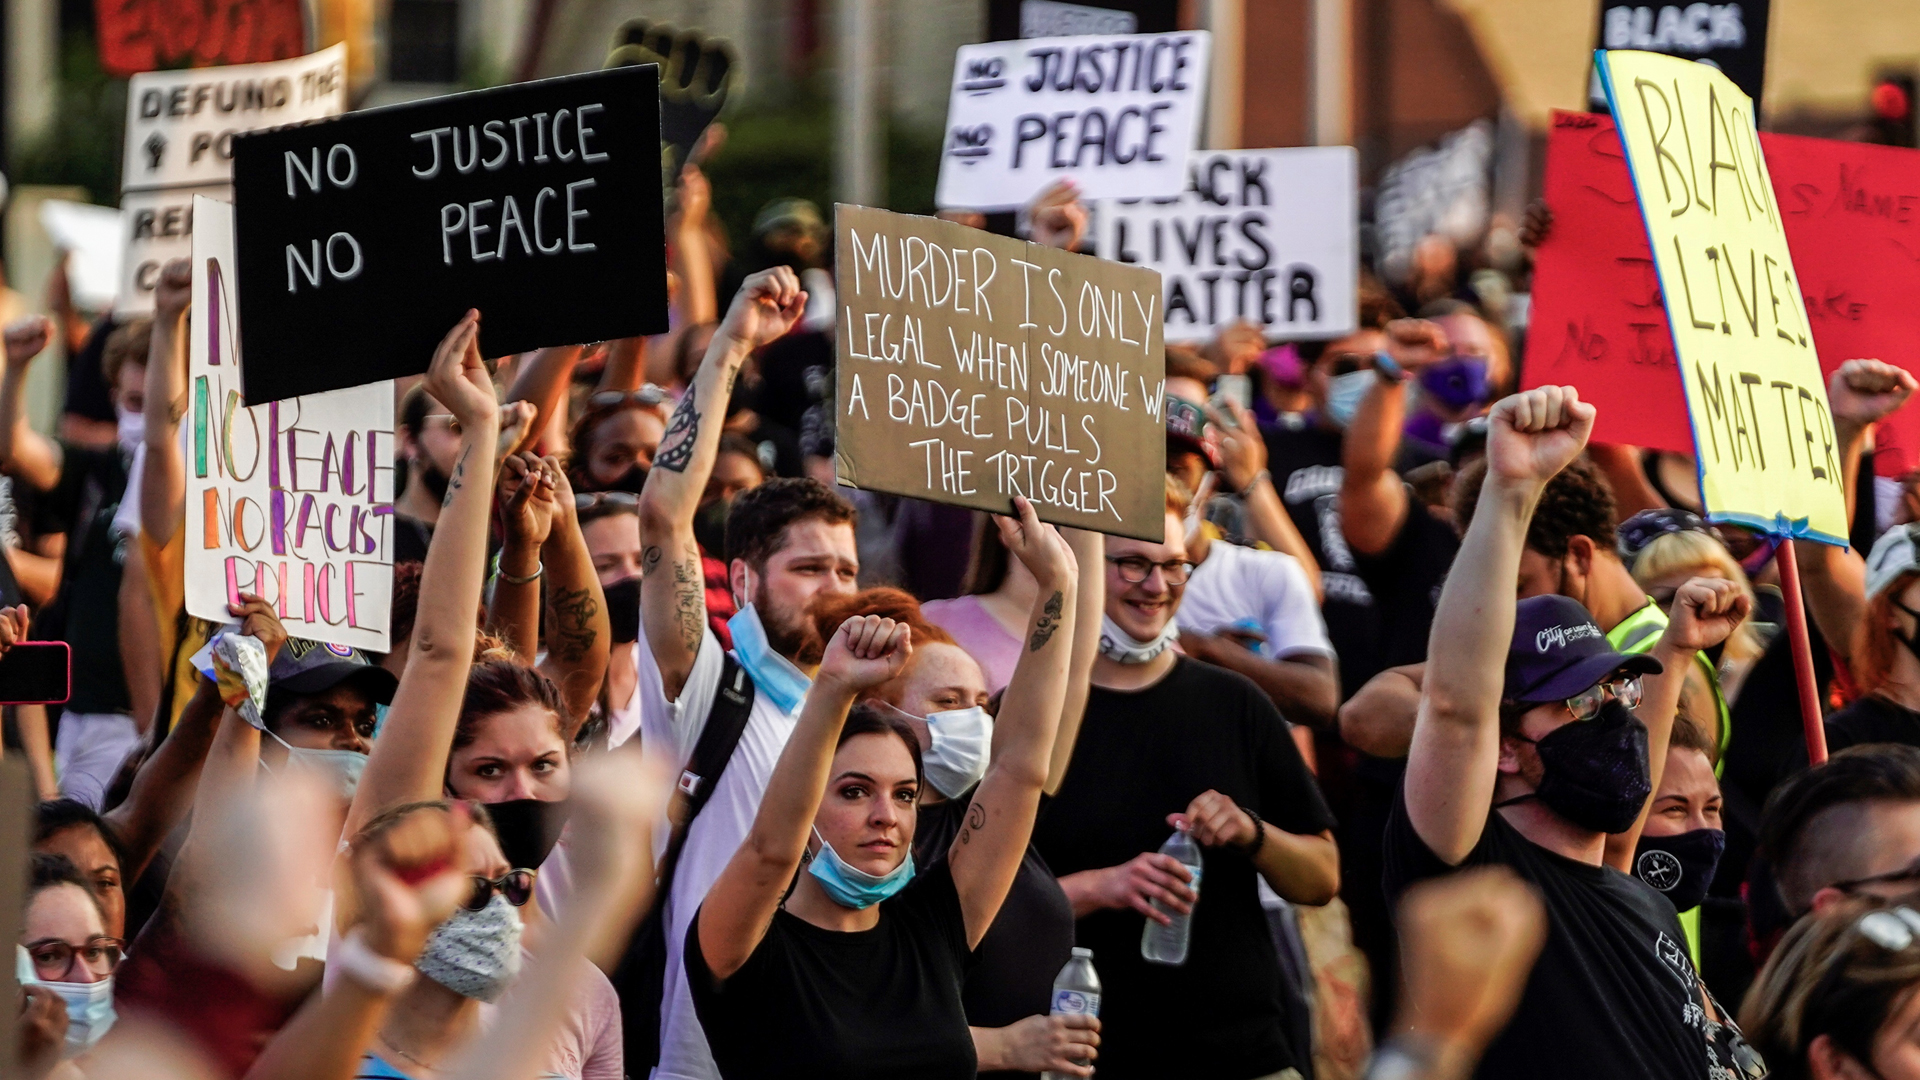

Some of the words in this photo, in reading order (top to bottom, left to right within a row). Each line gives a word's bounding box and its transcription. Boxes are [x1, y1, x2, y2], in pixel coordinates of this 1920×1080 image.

[965, 56, 1003, 79] NO
[1026, 36, 1195, 93] JUSTICE
[1604, 2, 1747, 48] BLACK
[139, 75, 293, 119] DEFUND
[301, 60, 342, 105] THE
[284, 142, 358, 198] NO
[409, 103, 610, 179] JUSTICE
[952, 122, 993, 147] NO
[1010, 101, 1171, 170] PEACE
[1633, 75, 1780, 233] BLACK
[285, 230, 364, 293] NO
[439, 178, 599, 266] PEACE
[1114, 211, 1275, 272] LIVES
[850, 227, 997, 323] MURDER
[1010, 257, 1068, 338] IS
[1078, 279, 1156, 356] ONLY
[1164, 264, 1323, 325] ATTER
[1673, 234, 1809, 349] LIVES
[845, 305, 942, 369] LEGAL
[948, 326, 1028, 391] WHEN
[1040, 342, 1131, 411] SOMEONE
[194, 374, 260, 482] NO
[268, 396, 395, 505] PEACE
[847, 373, 870, 420] A
[887, 373, 994, 439] BADGE
[1006, 396, 1102, 465] PULLS
[1694, 358, 1844, 495] MATTER
[909, 438, 977, 495] THE
[985, 450, 1123, 523] TRIGGER
[202, 486, 266, 553] NO
[269, 487, 394, 562] RACIST
[224, 555, 394, 635] POLICE
[1536, 624, 1567, 652] City
